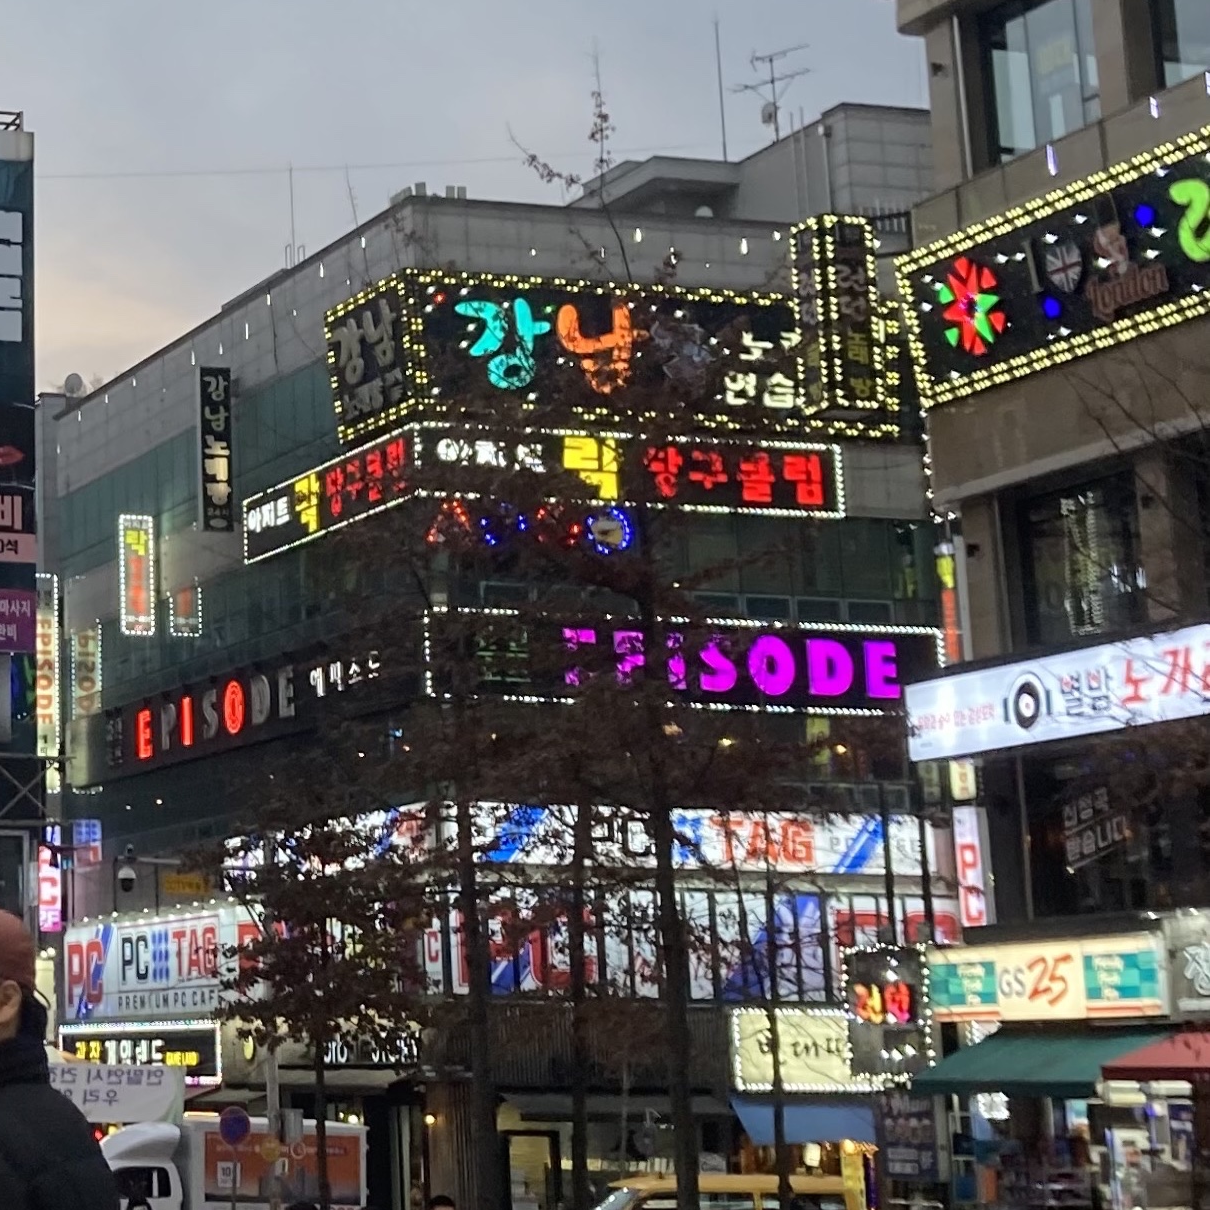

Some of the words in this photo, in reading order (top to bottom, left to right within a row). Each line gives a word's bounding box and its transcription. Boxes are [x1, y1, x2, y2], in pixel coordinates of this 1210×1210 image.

[454, 297, 649, 395] 강남
[202, 374, 229, 431] 강남
[247, 495, 291, 534] 아지트
[294, 472, 321, 533] 락
[135, 665, 296, 760] EPISODE
[708, 812, 817, 866] TAG
[957, 843, 985, 927] PC
[66, 938, 104, 1008] PC
[121, 934, 150, 982] PC
[171, 925, 218, 977] TAG
[118, 991, 170, 1011] PREMIUM
[173, 990, 187, 1009] PC
